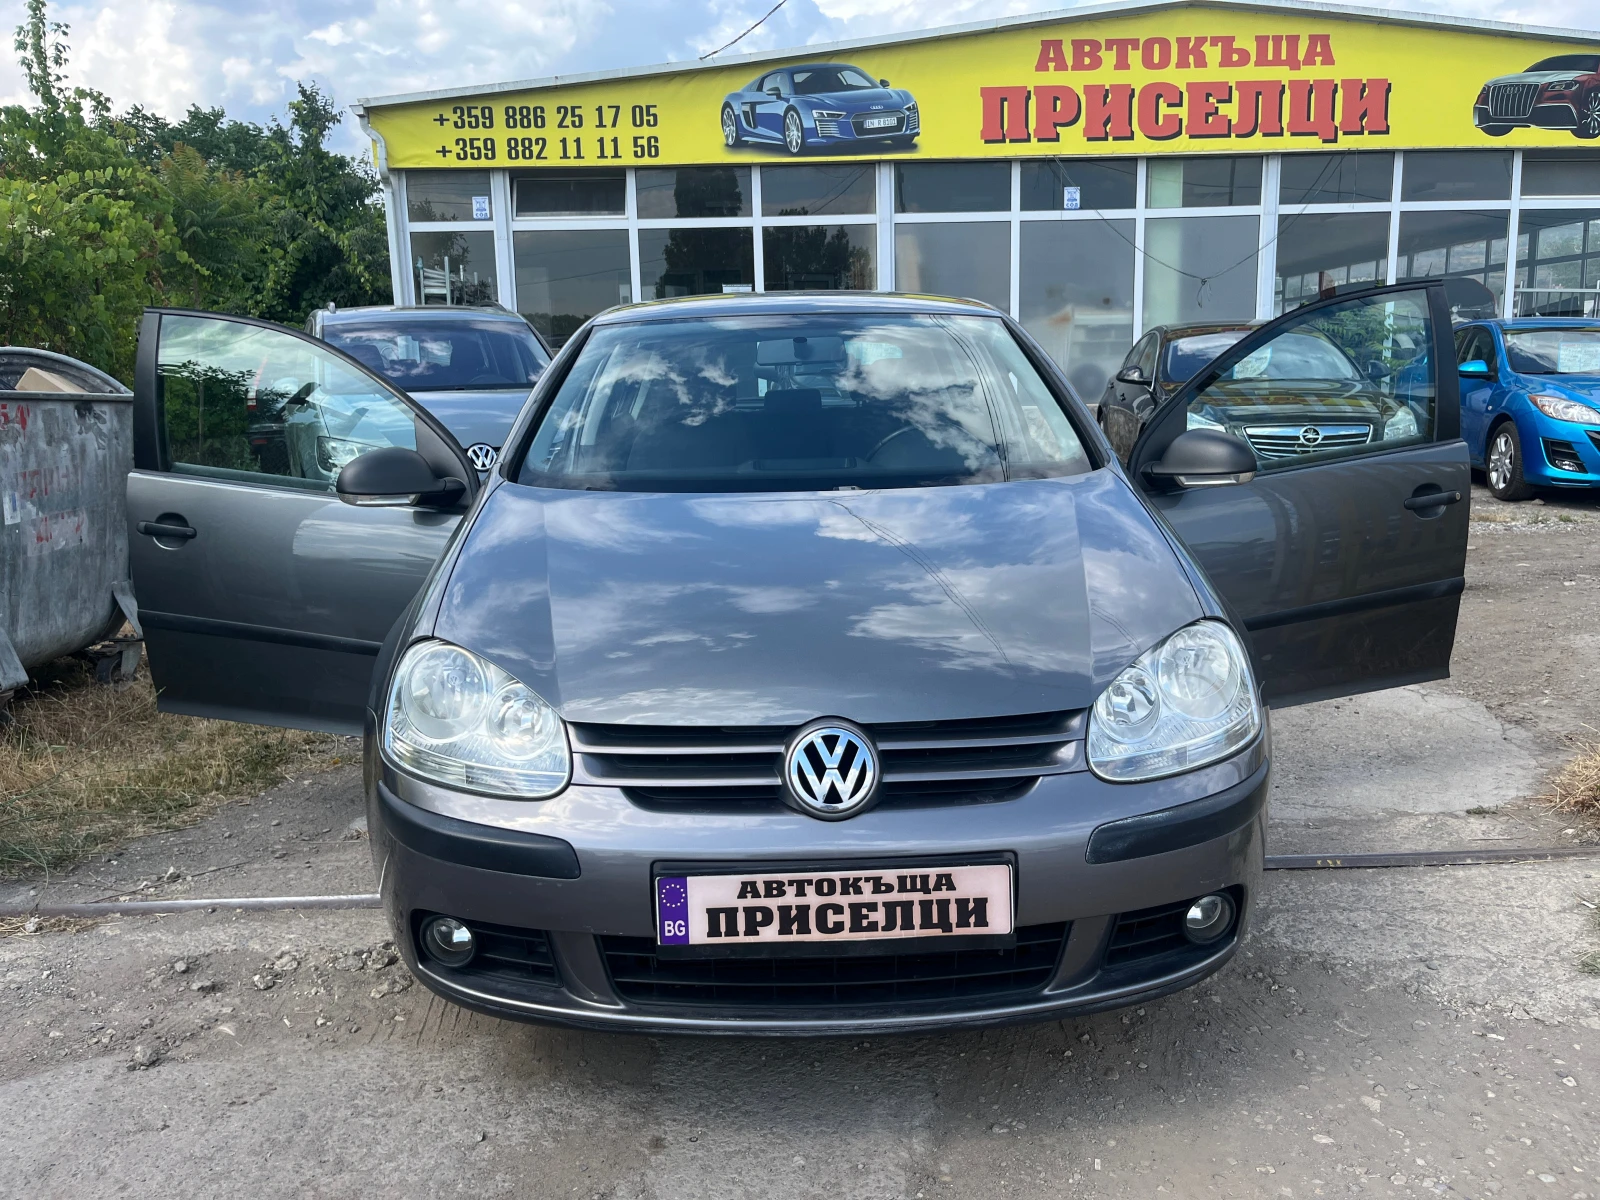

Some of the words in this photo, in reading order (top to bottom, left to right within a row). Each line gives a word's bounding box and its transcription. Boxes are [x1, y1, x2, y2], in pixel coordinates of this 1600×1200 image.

[1034, 34, 1336, 72] АВТОКЪЩА
[433, 105, 494, 129] +359
[504, 105, 546, 129] 886
[556, 105, 583, 129] 25
[595, 105, 621, 128] 17
[631, 104, 658, 128] 05
[979, 78, 1392, 143] ПРИСЕЛЦИ
[435, 137, 497, 161] +359
[506, 137, 548, 160] 882
[559, 137, 585, 160] 11
[596, 136, 622, 159] 11
[632, 136, 660, 158] 56
[736, 873, 957, 899] АВТОКЪЩА
[663, 920, 686, 937] BG
[705, 897, 989, 938] ПРИСЕЛЦИ
